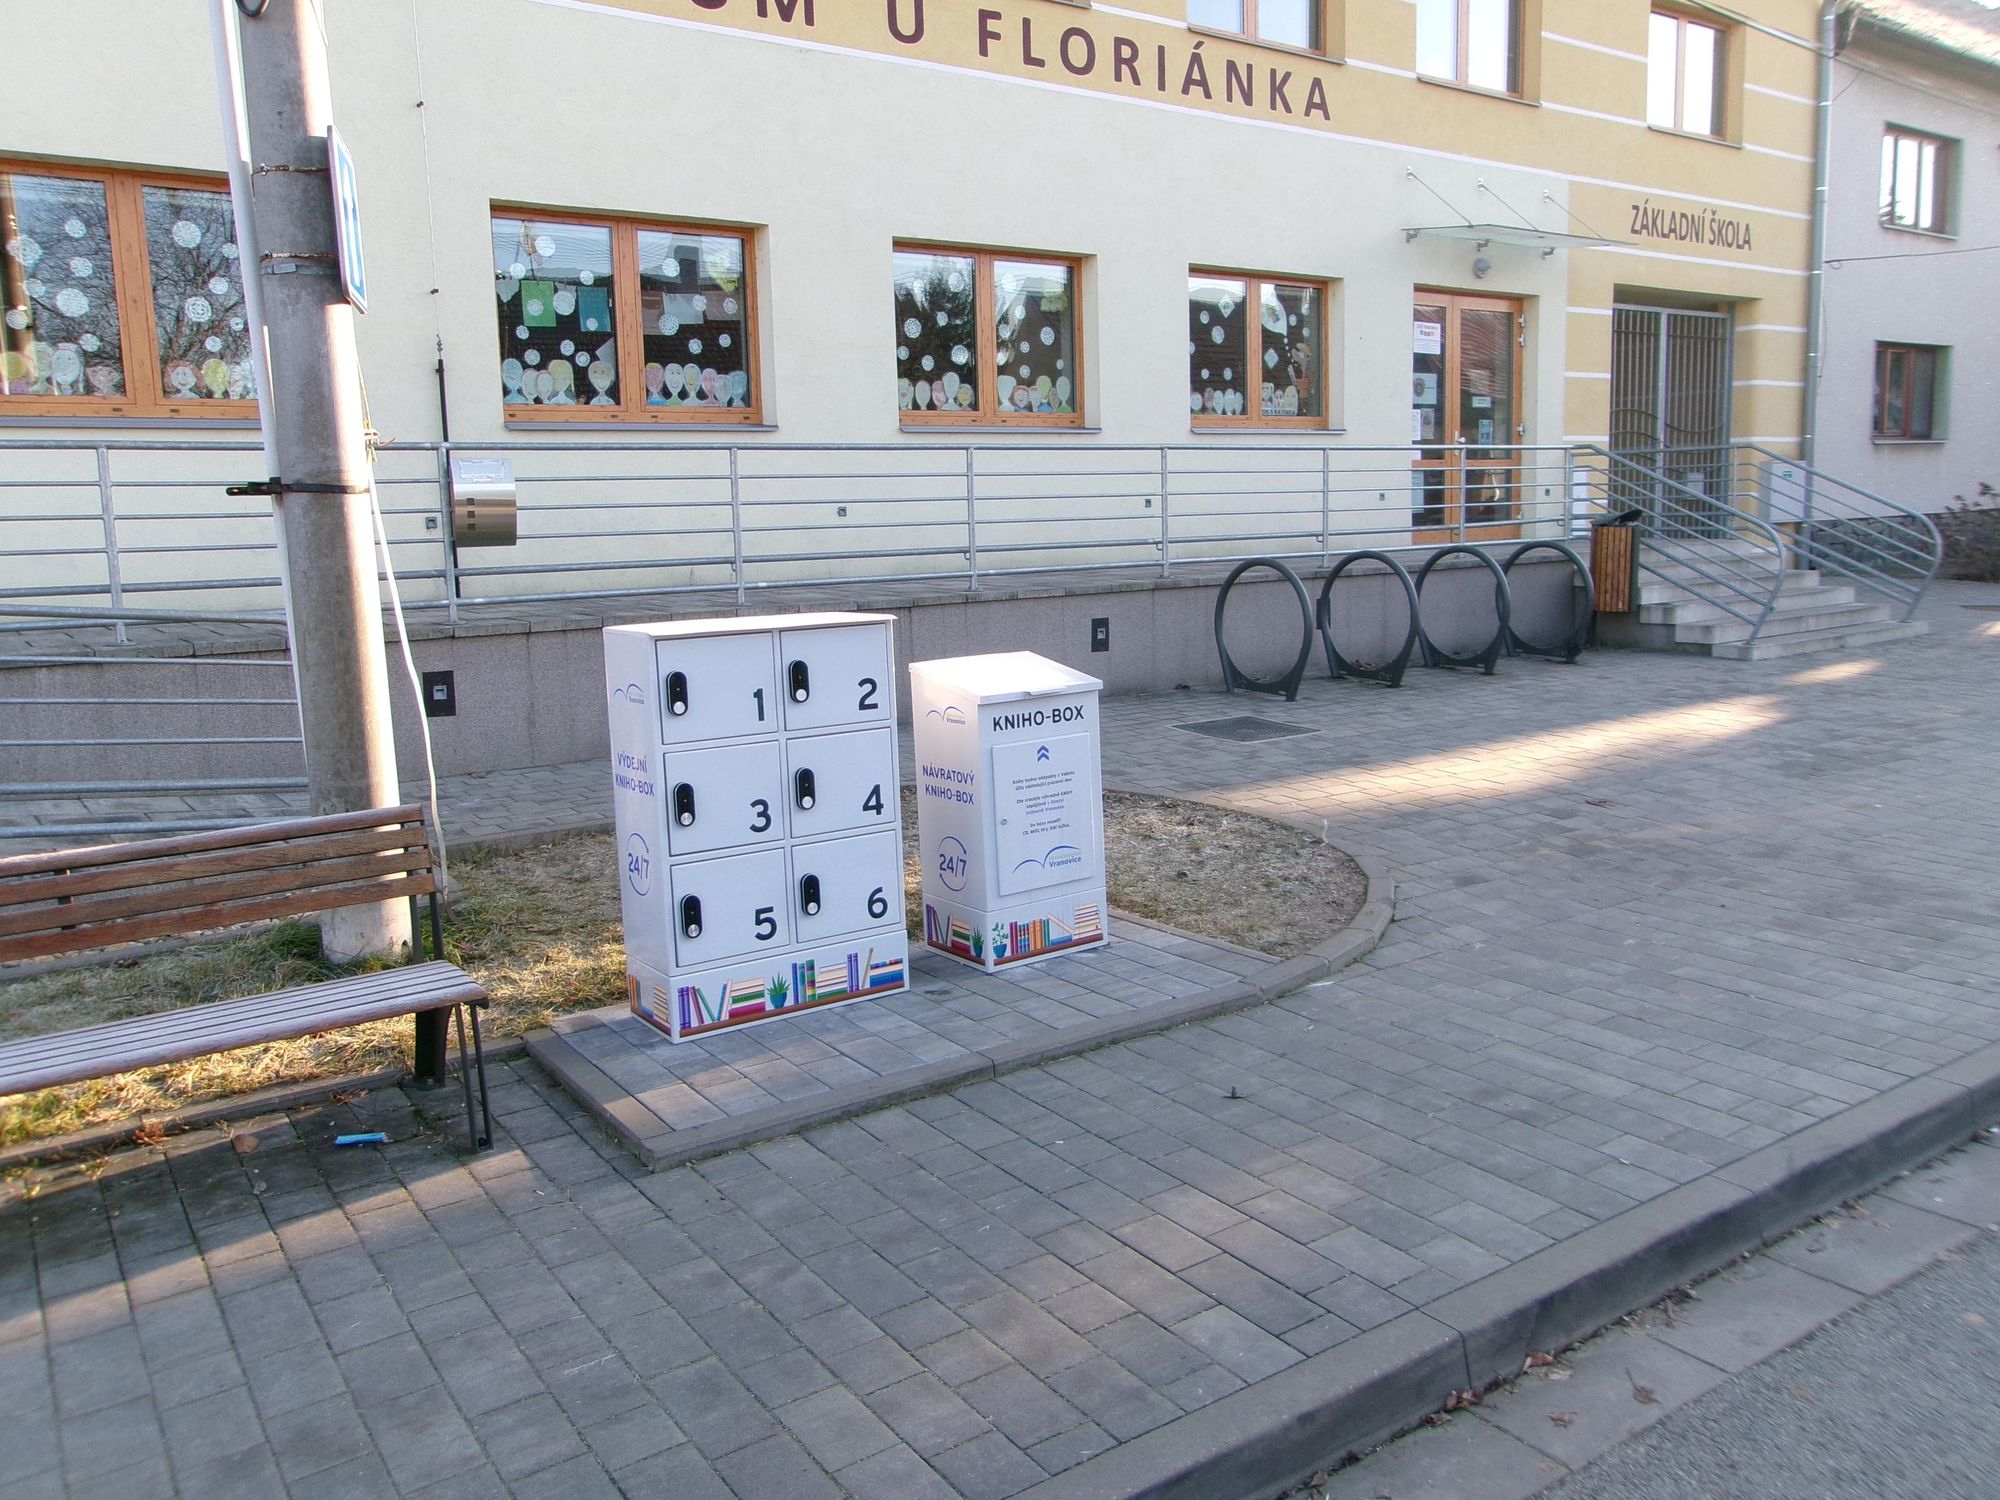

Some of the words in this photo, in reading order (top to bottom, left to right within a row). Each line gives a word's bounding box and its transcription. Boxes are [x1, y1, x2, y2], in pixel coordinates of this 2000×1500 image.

[887, 0, 925, 44] U
[978, 8, 1332, 121] FLORIÁNKA
[1630, 198, 1707, 244] ZÁKLADNÍ
[1708, 208, 1752, 251] ŠKOLA
[753, 688, 765, 722] 1
[858, 678, 879, 711] 2
[992, 704, 1084, 732] KNIHO-BOX
[617, 750, 648, 774] VÝDEJNÍ
[922, 762, 975, 787] NÁVRATOVÝ
[615, 773, 656, 798] KNIHO-BOX
[925, 783, 975, 806] KNIHO-BOX
[750, 799, 772, 833] 3
[863, 784, 885, 816] 4
[628, 852, 650, 881] 24/7
[940, 853, 967, 878] 24/7
[1048, 856, 1083, 868] Vranovice
[755, 906, 778, 941] 5
[868, 887, 889, 920] 6
